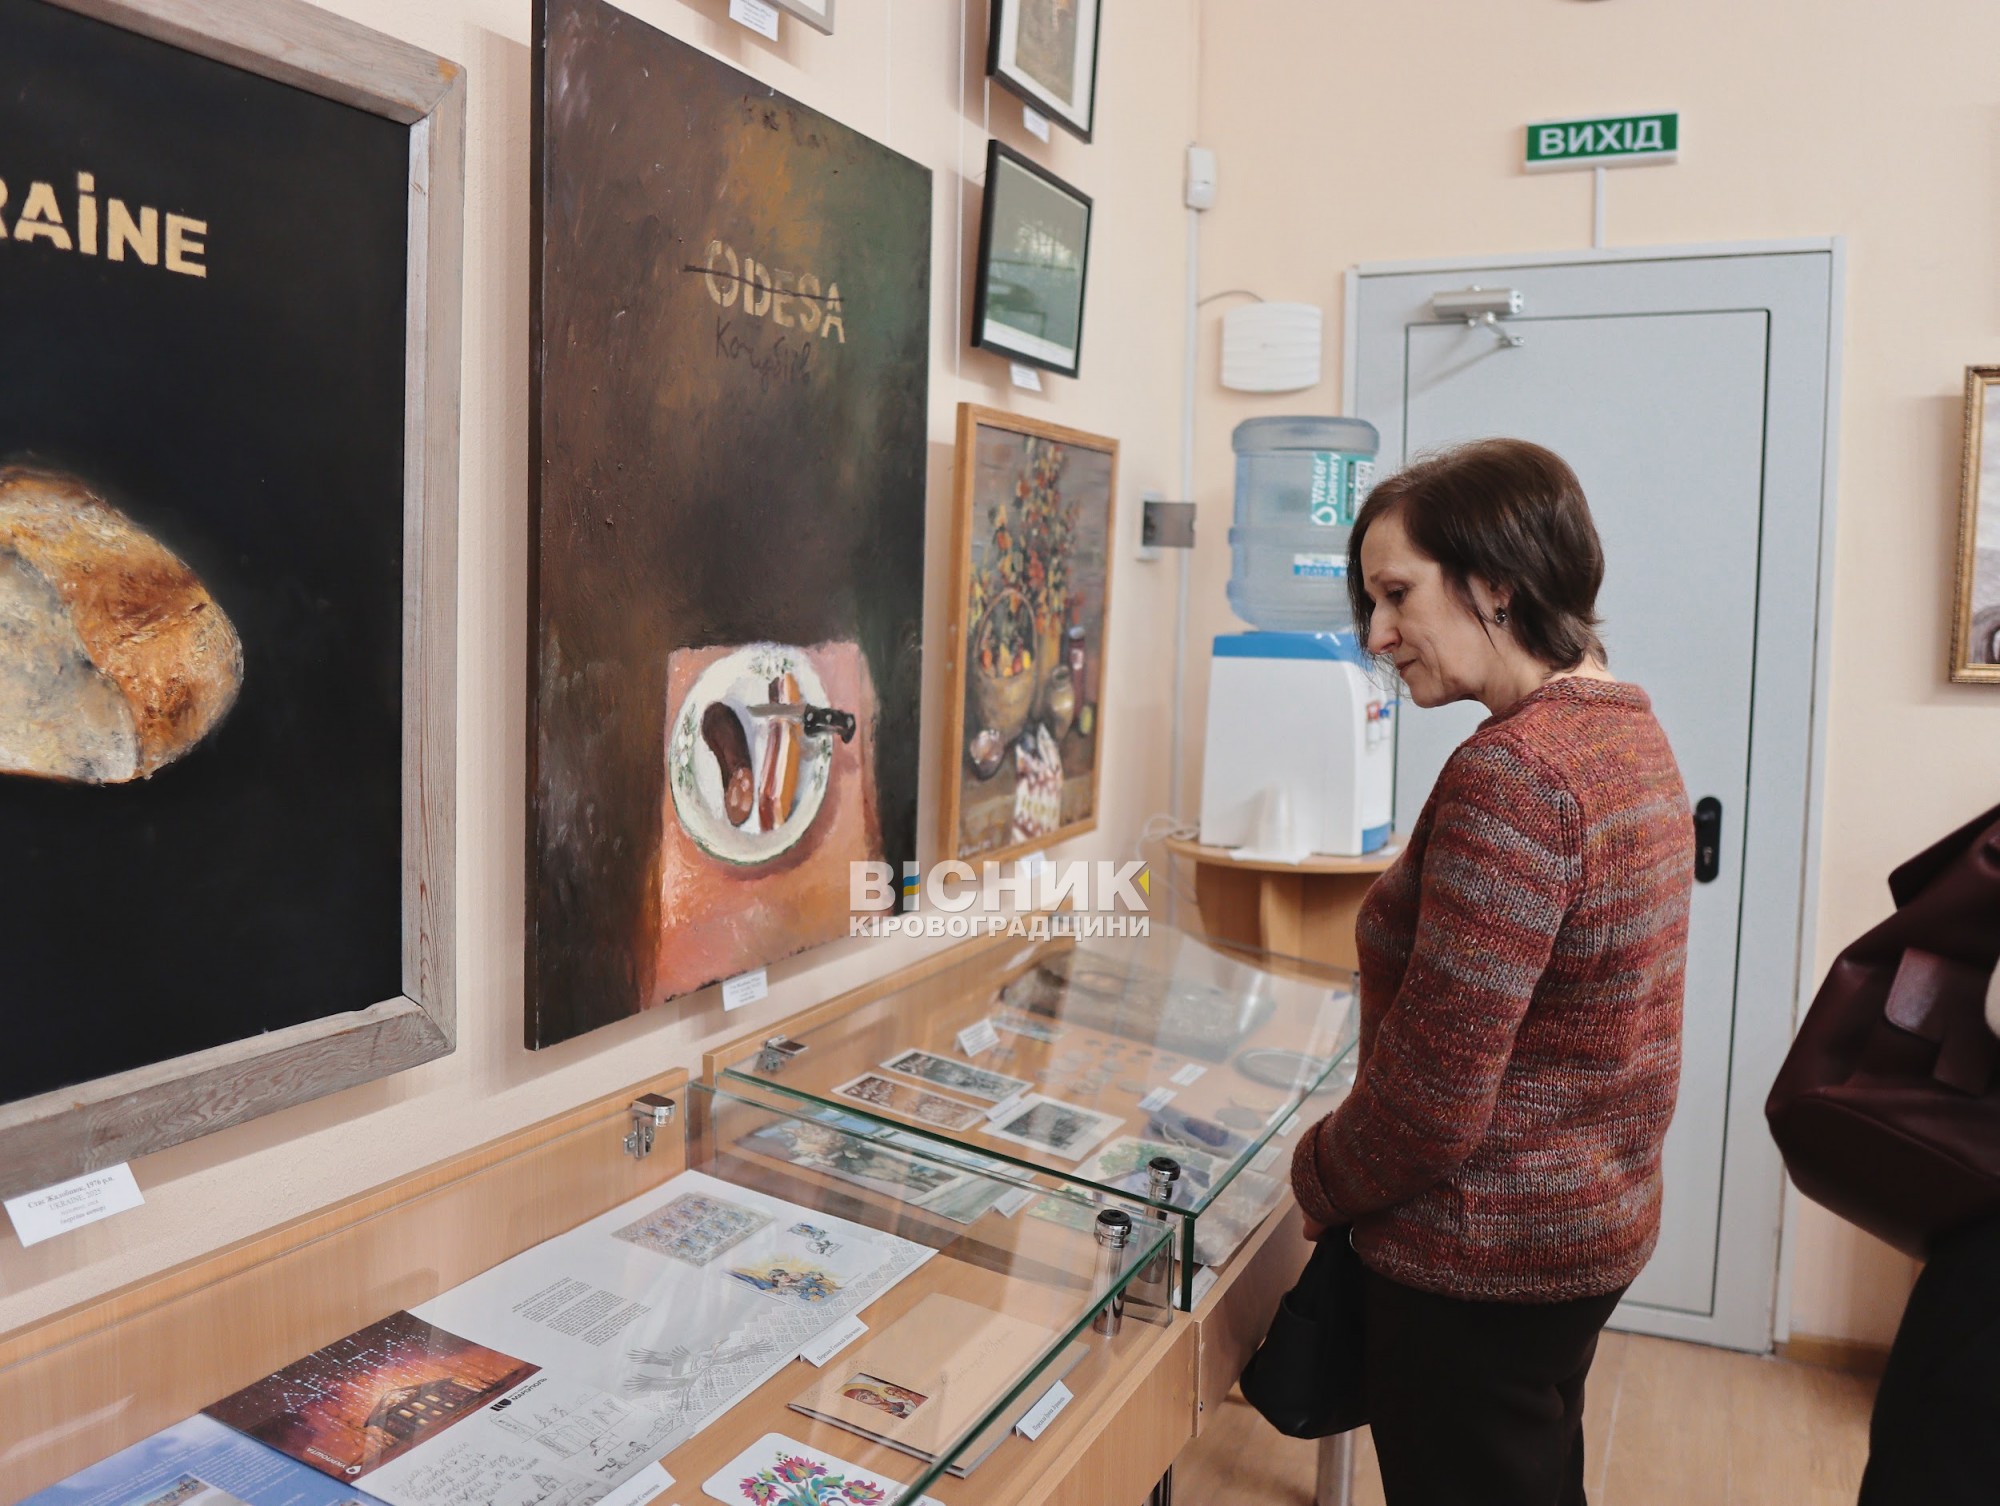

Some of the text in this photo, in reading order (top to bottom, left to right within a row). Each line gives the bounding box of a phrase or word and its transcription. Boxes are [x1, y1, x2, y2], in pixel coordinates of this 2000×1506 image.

[1538, 119, 1664, 156] ВИХІД
[705, 240, 845, 343] ODESA
[1312, 457, 1327, 504] Water
[1327, 452, 1341, 504] Delivery
